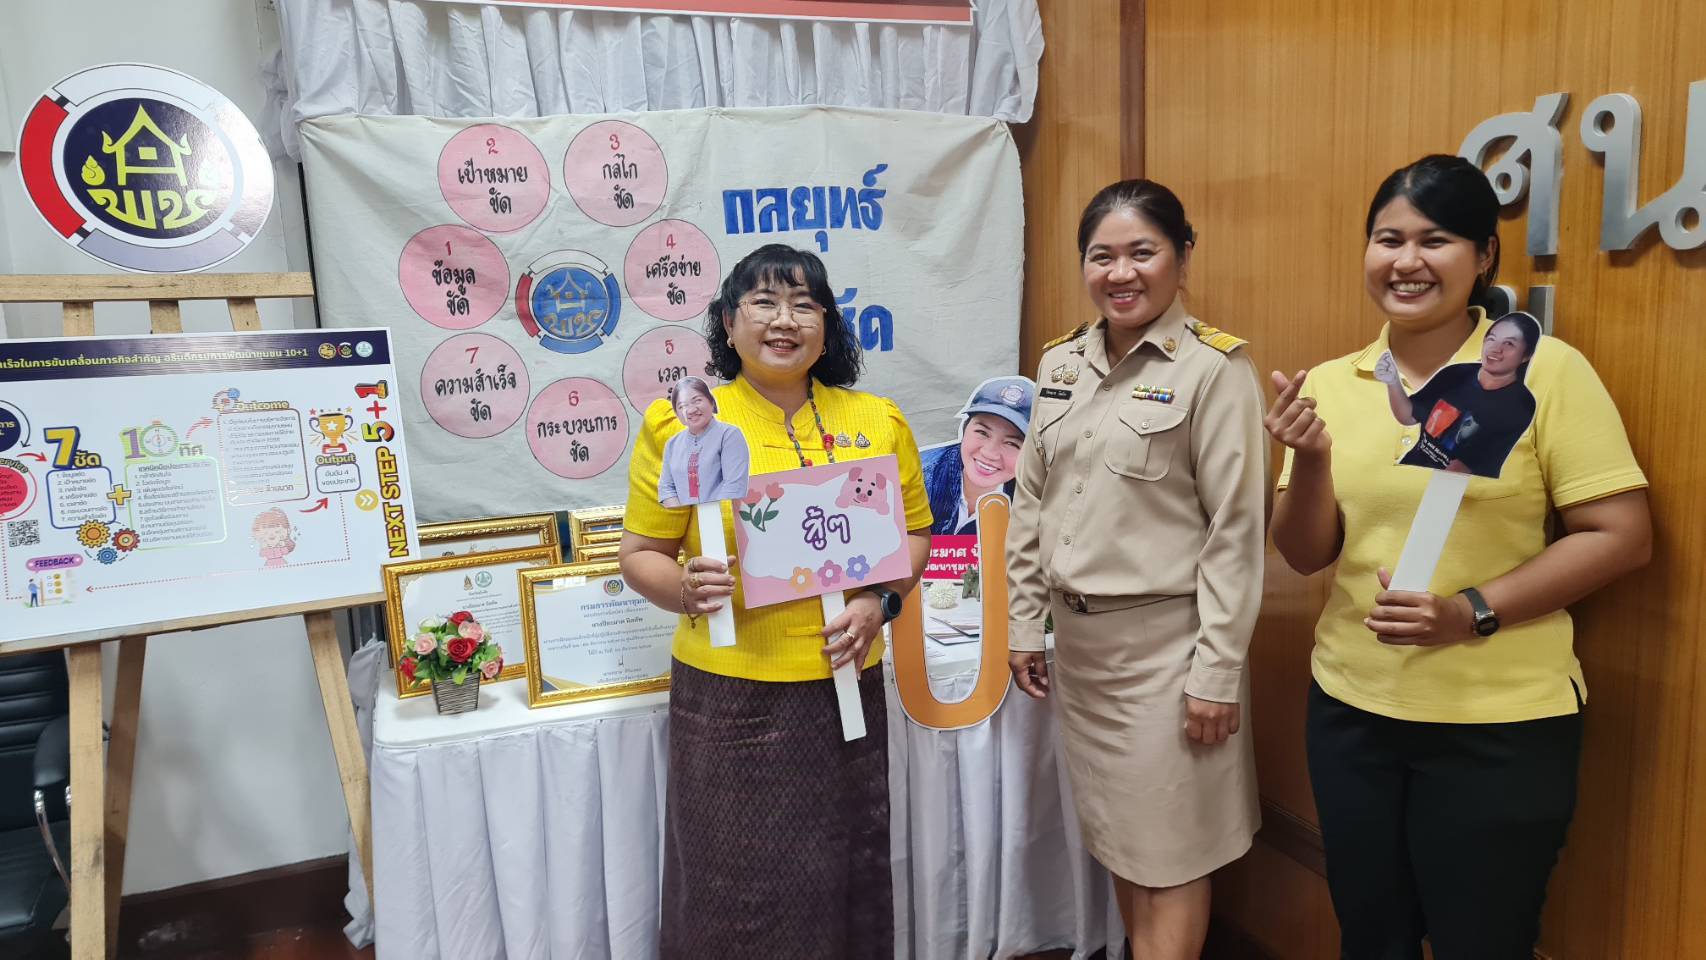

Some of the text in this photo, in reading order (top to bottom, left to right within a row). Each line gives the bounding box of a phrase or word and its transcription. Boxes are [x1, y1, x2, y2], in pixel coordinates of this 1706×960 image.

[486, 137, 499, 155] 2
[609, 134, 621, 150] 3
[457, 158, 528, 184] เป้าหมาย
[602, 153, 638, 179] กลไก
[489, 188, 512, 214] ชัด
[613, 184, 634, 209] ชัด
[722, 163, 889, 252] กลยุทธ์
[445, 241, 452, 255] 1
[665, 233, 676, 249] 4
[431, 261, 476, 293] ข้อมูล
[646, 254, 701, 279] เครือข่าย
[446, 289, 470, 316] ชัด
[666, 282, 686, 305] ชัด
[285, 347, 309, 358] 10+1
[465, 346, 480, 364] 7
[665, 339, 675, 355] 5
[435, 364, 517, 397] ความสำเร็จ
[658, 365, 688, 383] เวลา
[470, 398, 492, 423] ชัด
[568, 391, 580, 407] 6
[537, 415, 618, 438] กระบวนการ
[43, 426, 102, 470] 7 ชัด
[315, 453, 356, 465] Output
[569, 441, 590, 464] ชัด
[354, 379, 409, 558] NEXT STEP 5+1
[801, 505, 851, 551] สู้ๆ
[34, 556, 74, 568] FEEDBACK
[929, 547, 967, 558] ะมาศ
